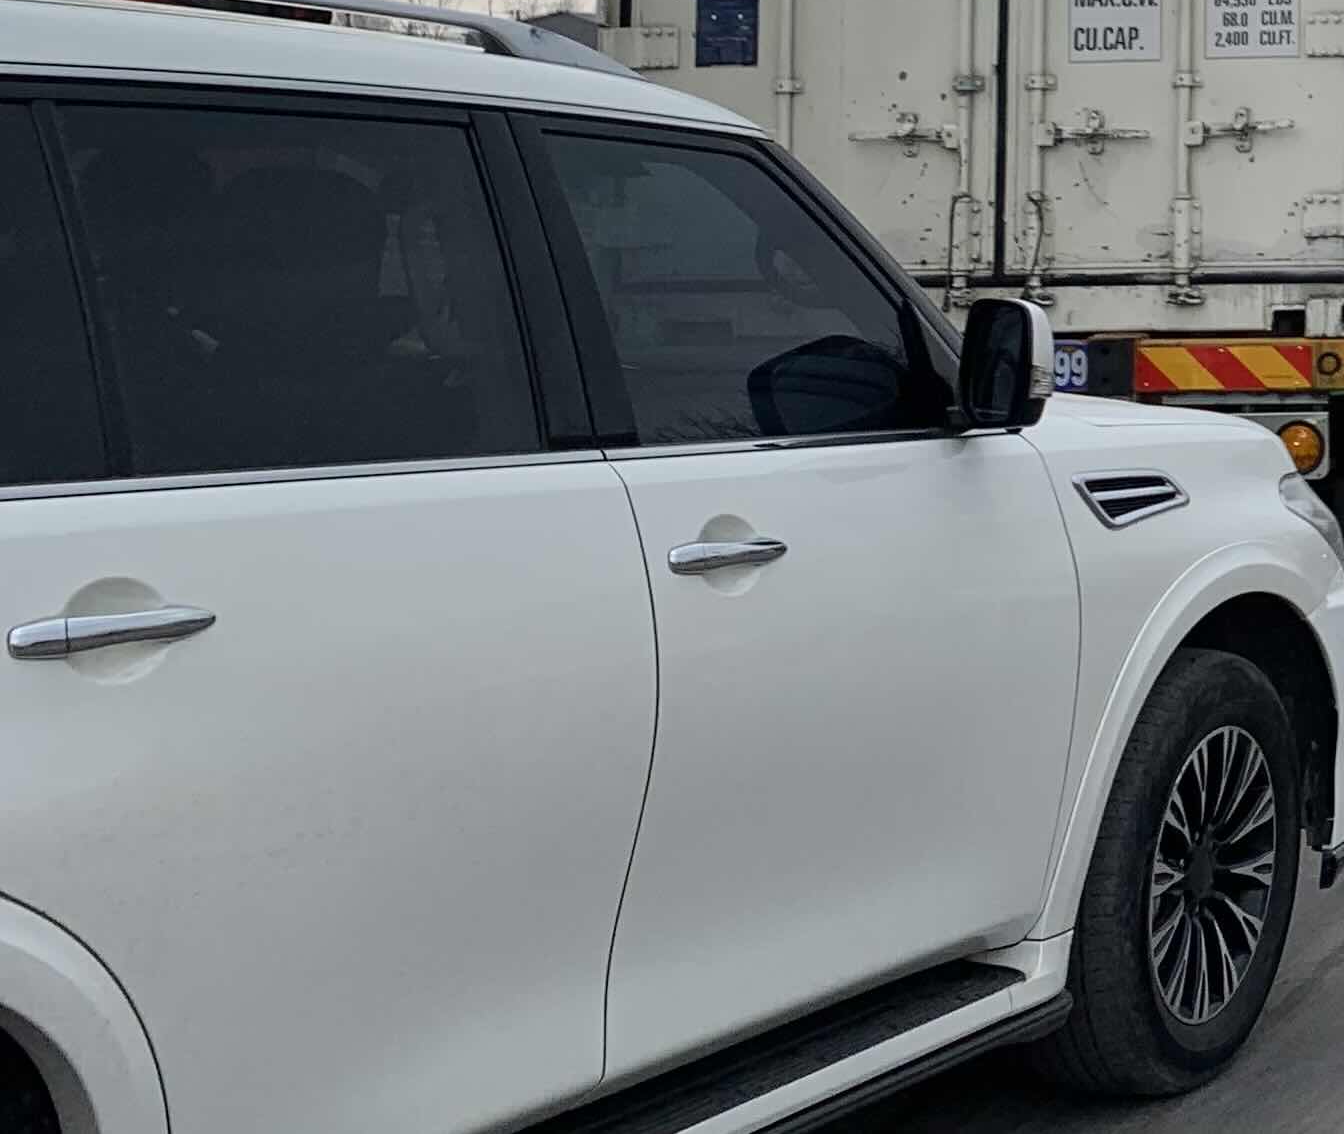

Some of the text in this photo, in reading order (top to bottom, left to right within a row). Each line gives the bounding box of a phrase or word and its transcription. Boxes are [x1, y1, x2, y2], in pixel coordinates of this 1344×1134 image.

[1260, 10, 1295, 26] CU.M.
[1073, 27, 1145, 52] CU.CAP.
[1259, 29, 1295, 46] CU.FT.
